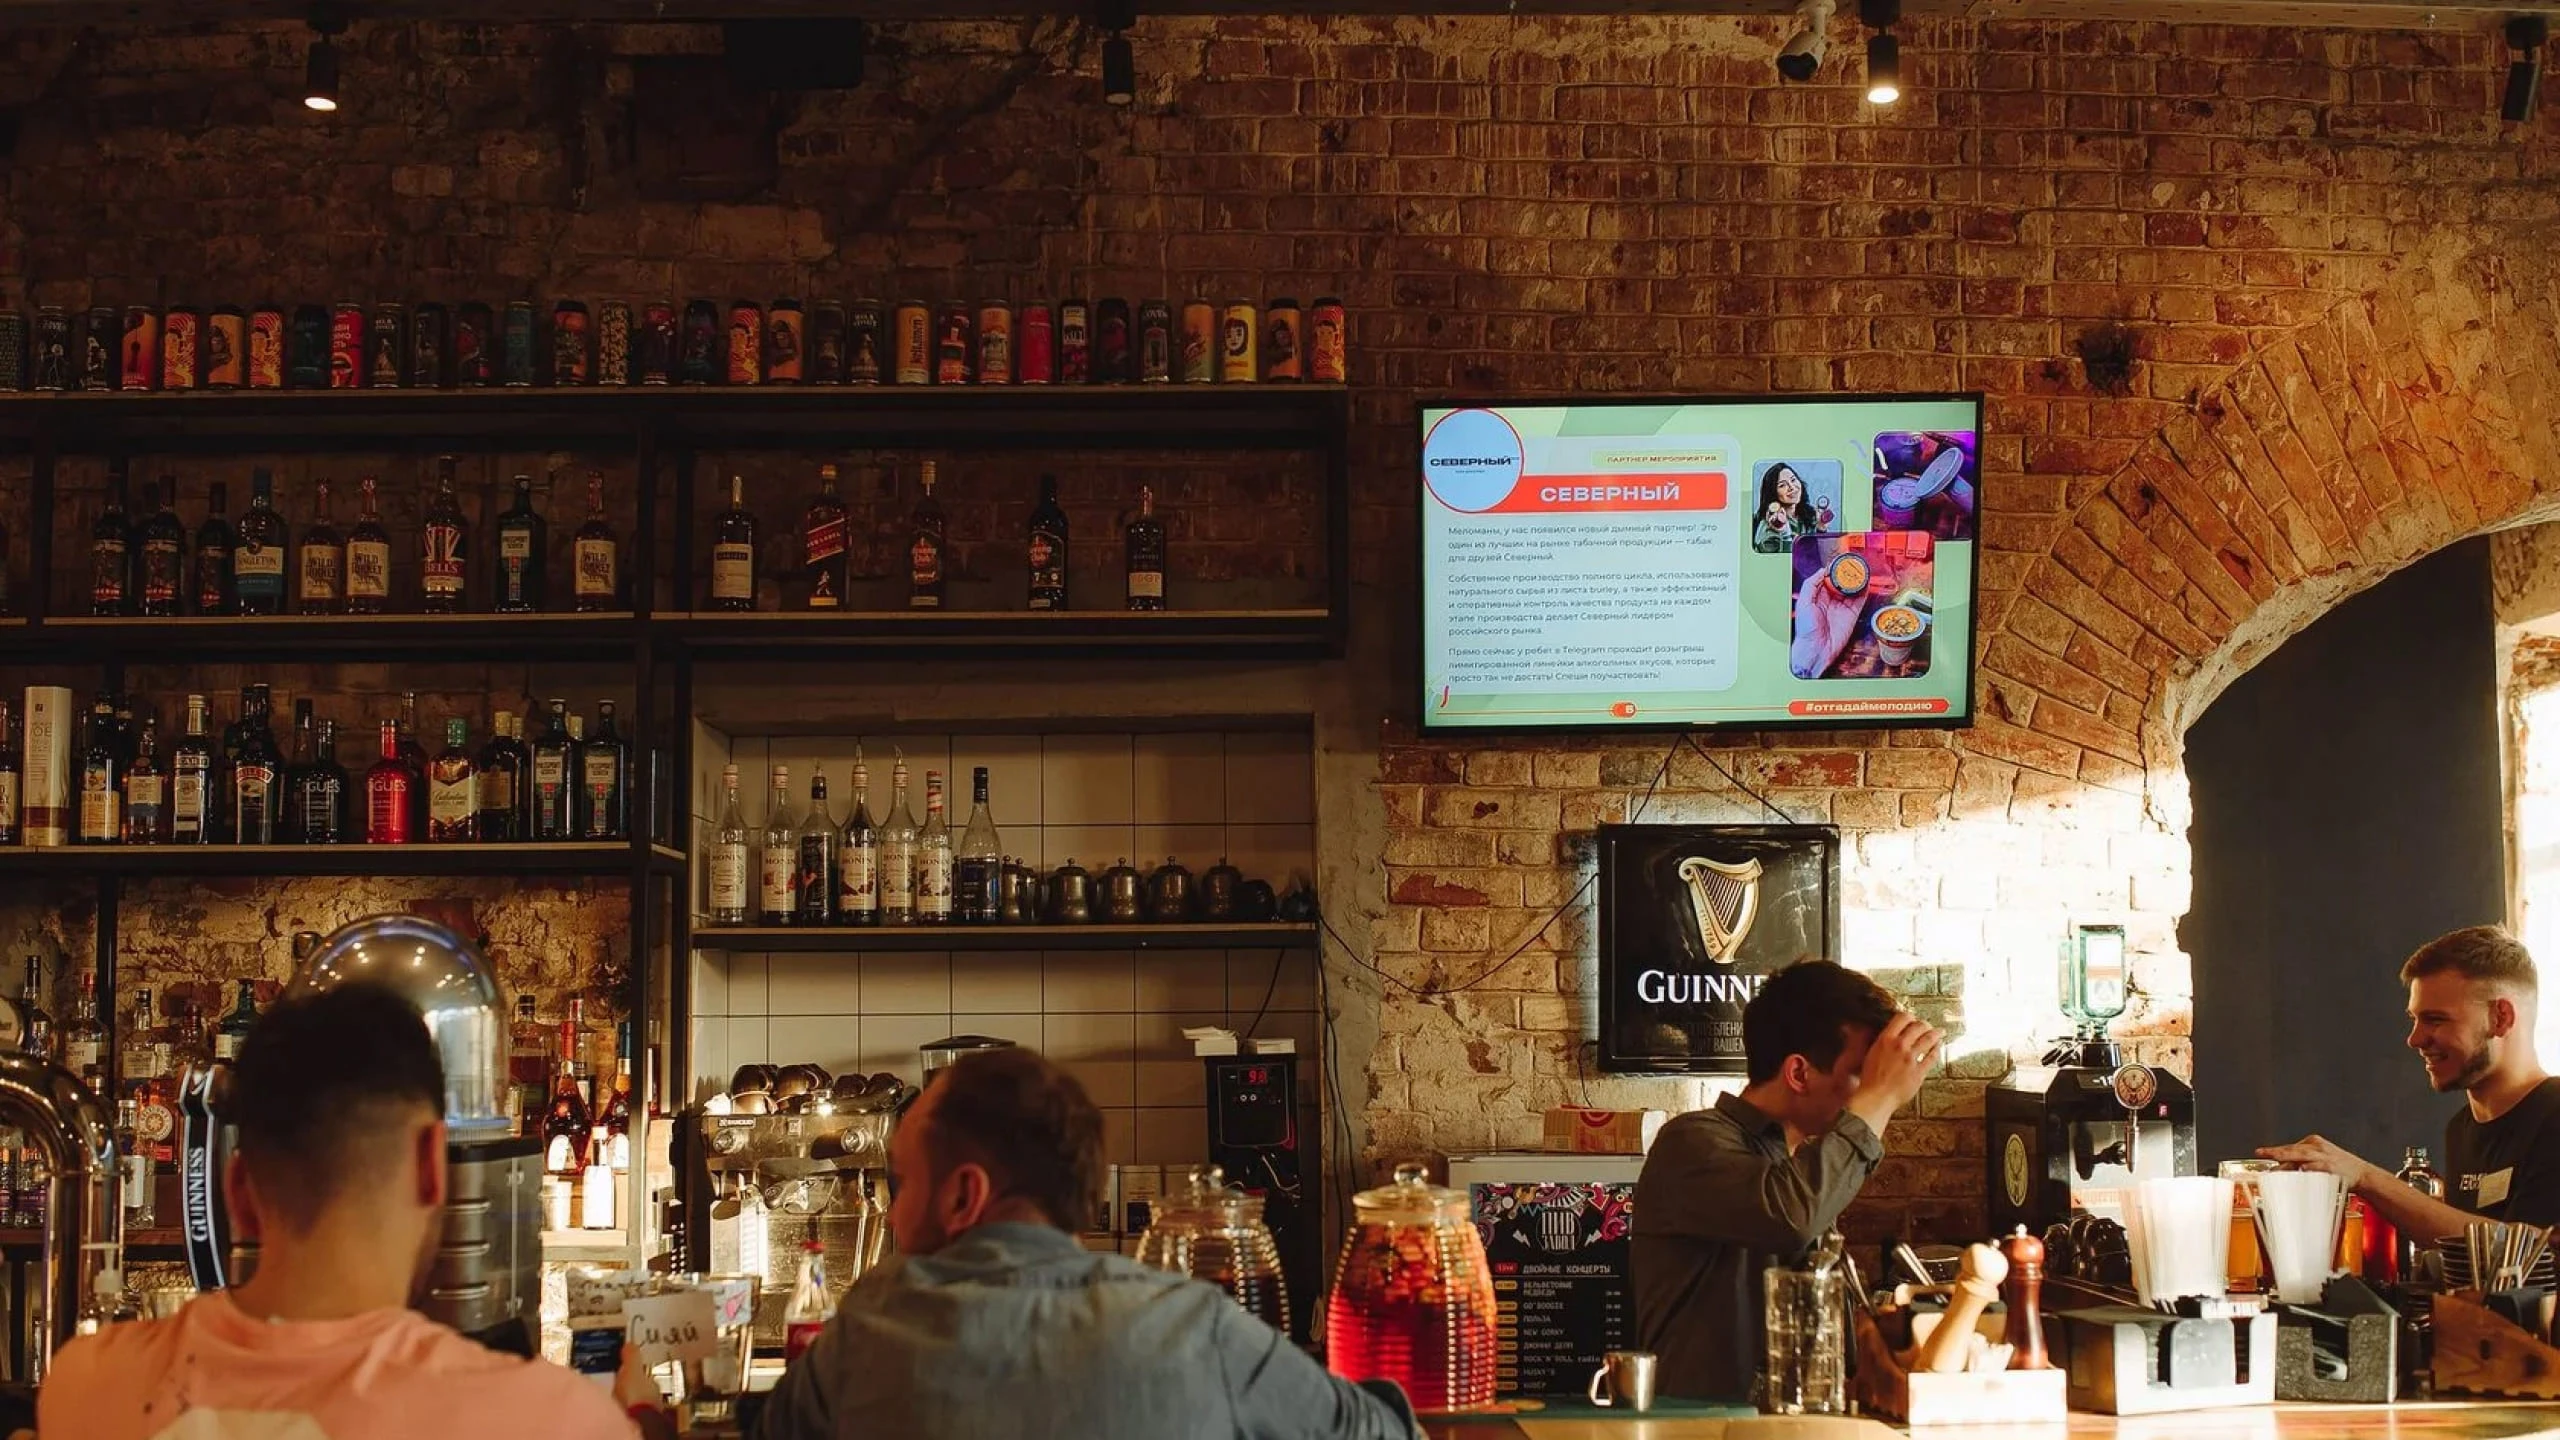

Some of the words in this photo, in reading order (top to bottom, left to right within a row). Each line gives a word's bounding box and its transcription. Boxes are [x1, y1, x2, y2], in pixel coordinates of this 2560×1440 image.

[1430, 456, 1511, 467] СЕВЕРНЫЙ
[1540, 482, 1680, 502] СЕВЕРНЫЙ
[1530, 526, 1576, 534] появился
[1578, 525, 1610, 533] новый
[1611, 524, 1652, 533] дымный
[1700, 523, 1718, 531] Это
[1448, 540, 1473, 549] один
[1488, 540, 1524, 550] лучших
[1540, 540, 1570, 549] рынке
[1573, 537, 1618, 547] табачной
[1619, 538, 1673, 547] продукции
[1686, 535, 1713, 545] табак
[1448, 554, 1465, 562] для
[1467, 552, 1501, 563] друзей
[1448, 573, 1511, 583] Собственное
[1512, 573, 1580, 582] производство
[1581, 573, 1622, 581] полного
[1657, 571, 1730, 579] использование
[1448, 587, 1514, 597] натурального
[1515, 587, 1545, 596] сырья
[1560, 586, 1587, 594] листа
[1631, 585, 1658, 593] также
[1660, 583, 1727, 593] эффективный
[1456, 600, 1522, 609] оперативный
[1523, 600, 1569, 608] контроль
[1570, 599, 1612, 607] качества
[1614, 599, 1659, 607] продукта
[1673, 598, 1711, 606] каждом
[1448, 614, 1476, 622] этапе
[1477, 613, 1543, 622] производства
[1544, 614, 1579, 622] делает
[1580, 611, 1629, 621] Северный
[1631, 612, 1674, 620] лидером
[1448, 627, 1510, 636] российского
[1448, 648, 1480, 656] Прямо
[1482, 647, 1516, 655] сейчас
[1562, 645, 1606, 654] Telegram
[1607, 645, 1653, 653] проходит
[1654, 645, 1705, 654] розыгрыш
[1448, 660, 1531, 669] лимитированной
[1576, 659, 1638, 667] алкогольных
[1676, 658, 1717, 666] которые
[1555, 673, 1589, 681] Спеши
[1806, 701, 1934, 713] #отгадаймелодию
[1637, 969, 1769, 1003] GUINNE
[188, 1146, 208, 1242] GUINNESS
[1566, 1264, 1612, 1274] КОНЦЕРТЫ
